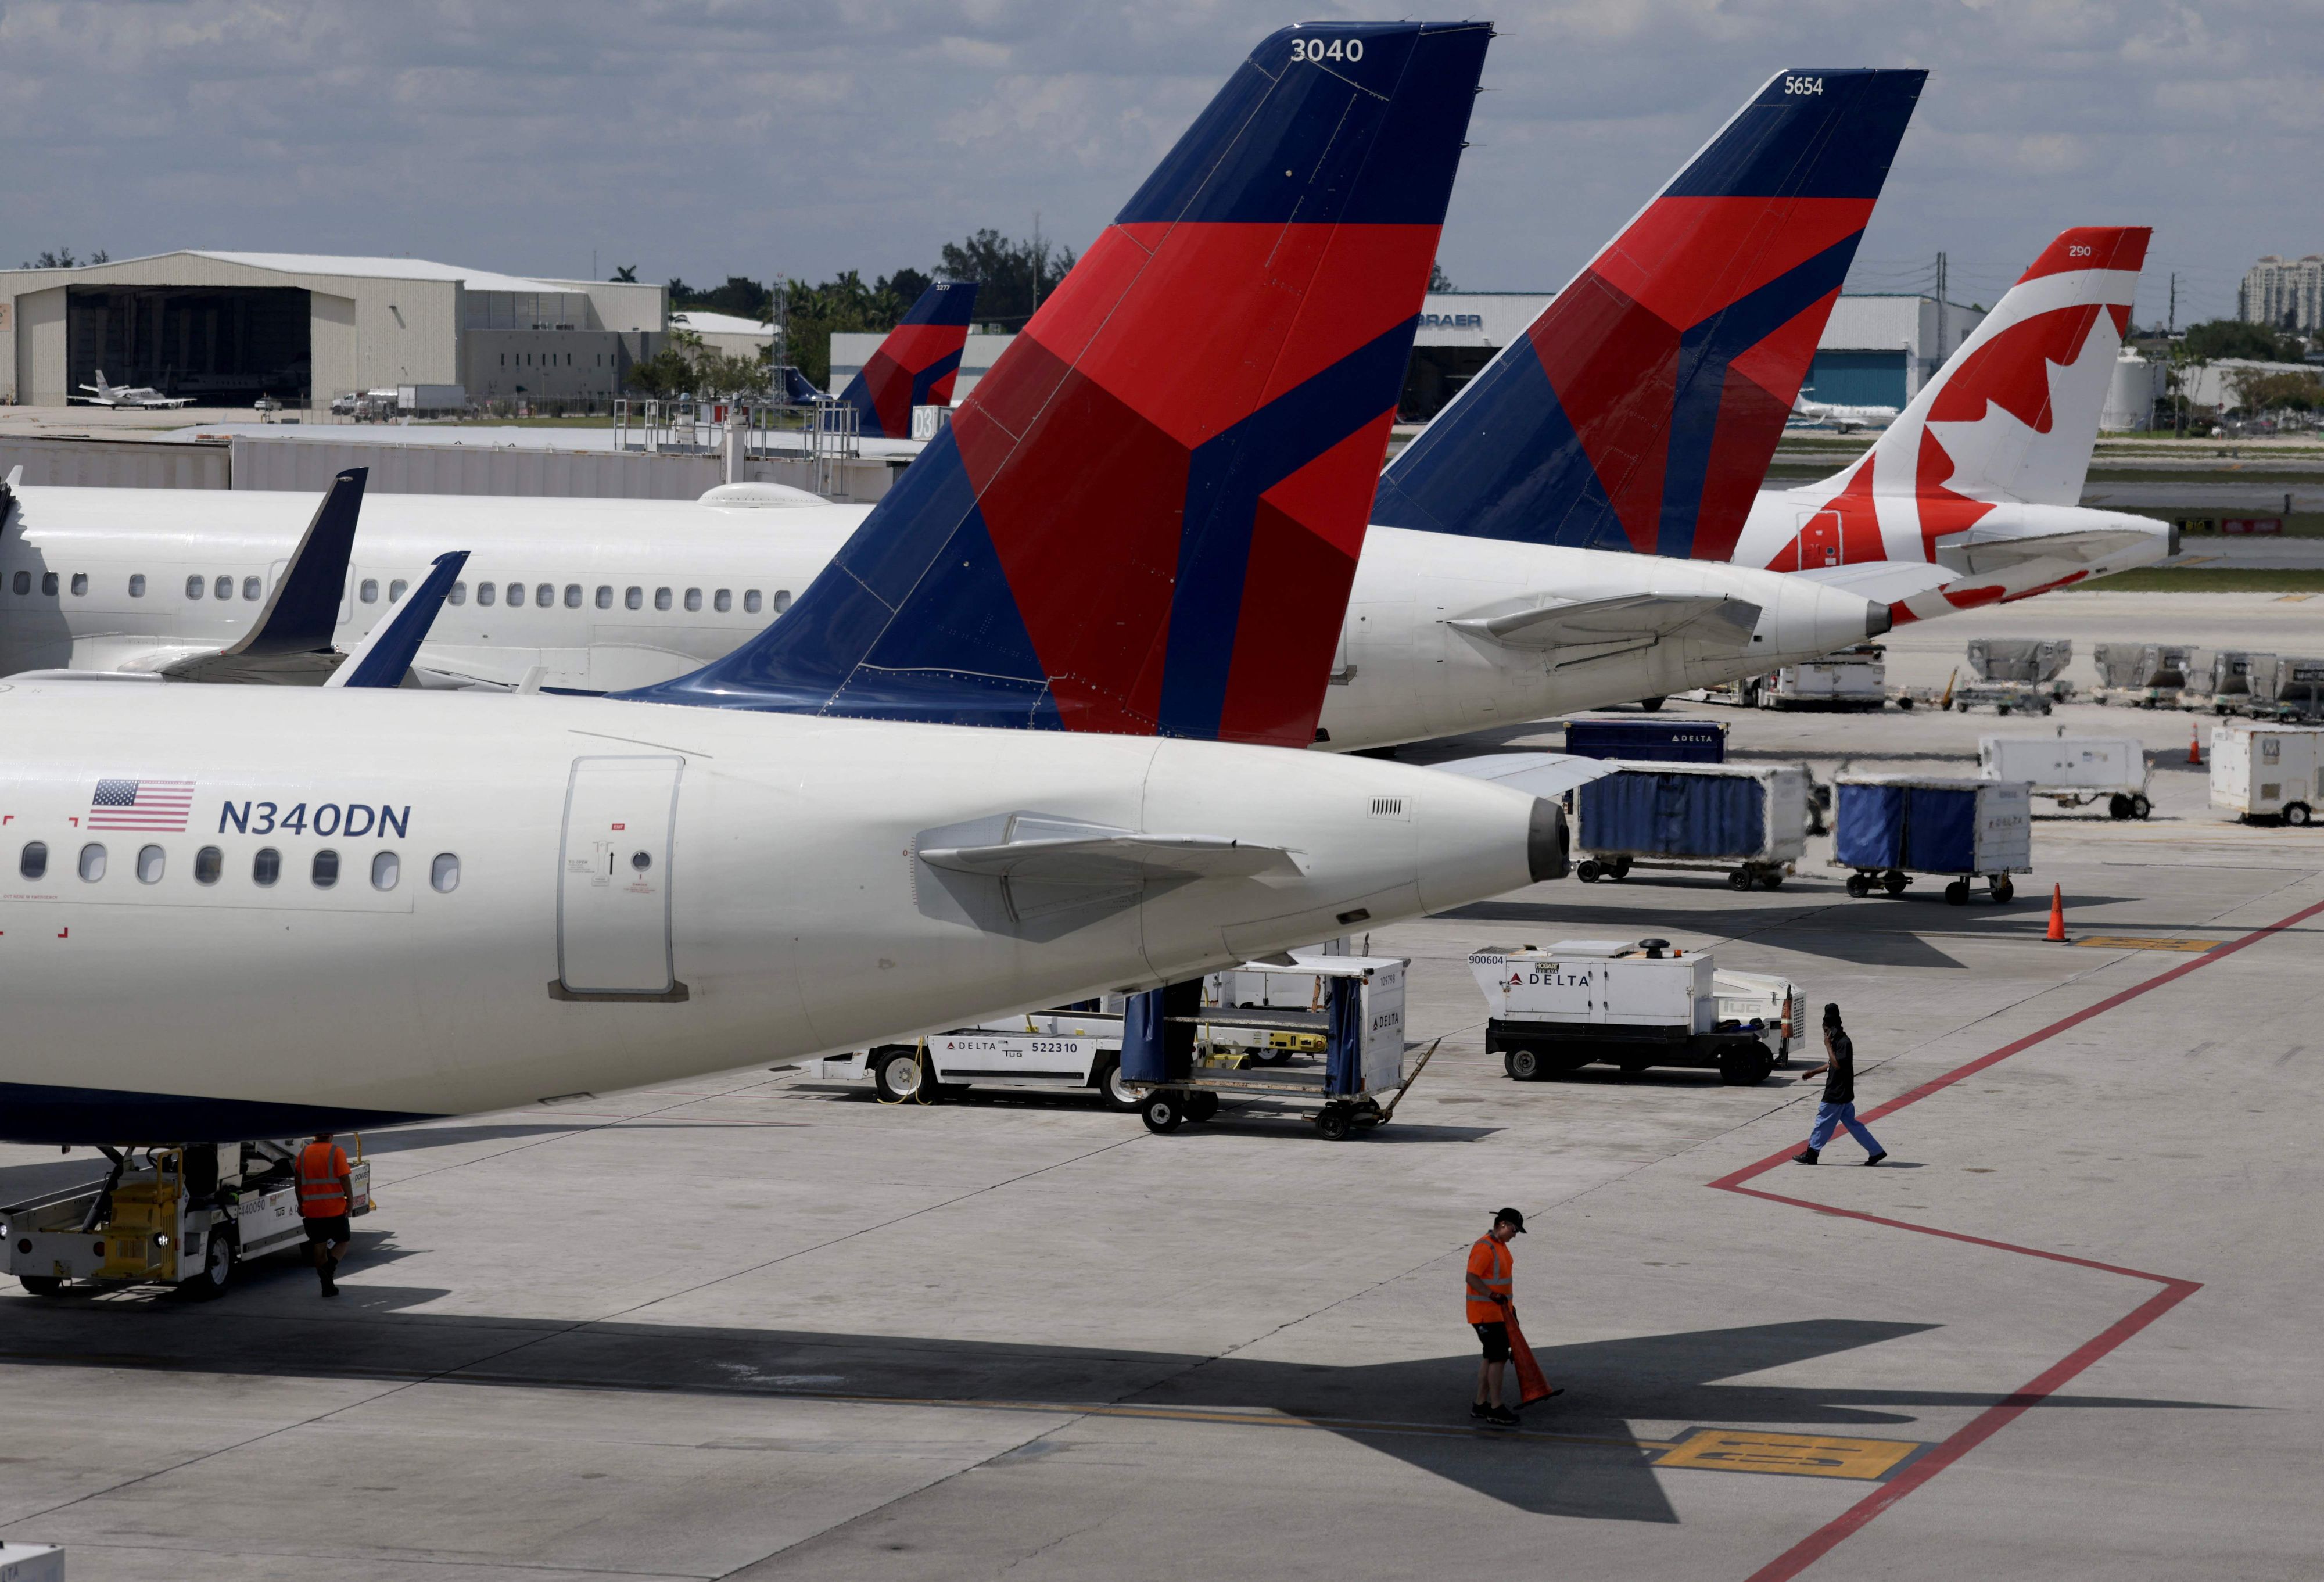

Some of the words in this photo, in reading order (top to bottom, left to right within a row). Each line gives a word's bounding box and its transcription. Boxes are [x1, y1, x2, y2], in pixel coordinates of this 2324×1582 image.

[1290, 38, 1364, 62] 3040
[1784, 76, 1823, 95] 5654
[2069, 245, 2091, 256] 290
[914, 408, 932, 437] D3
[218, 801, 411, 838] N340DN
[1469, 955, 1504, 964] 900604
[1529, 974, 1589, 987] DELTA
[1380, 1012, 1398, 1028] DELTA
[1032, 1042, 1078, 1053] 522310
[241, 1199, 266, 1217] 440090
[274, 1207, 285, 1217] TUG
